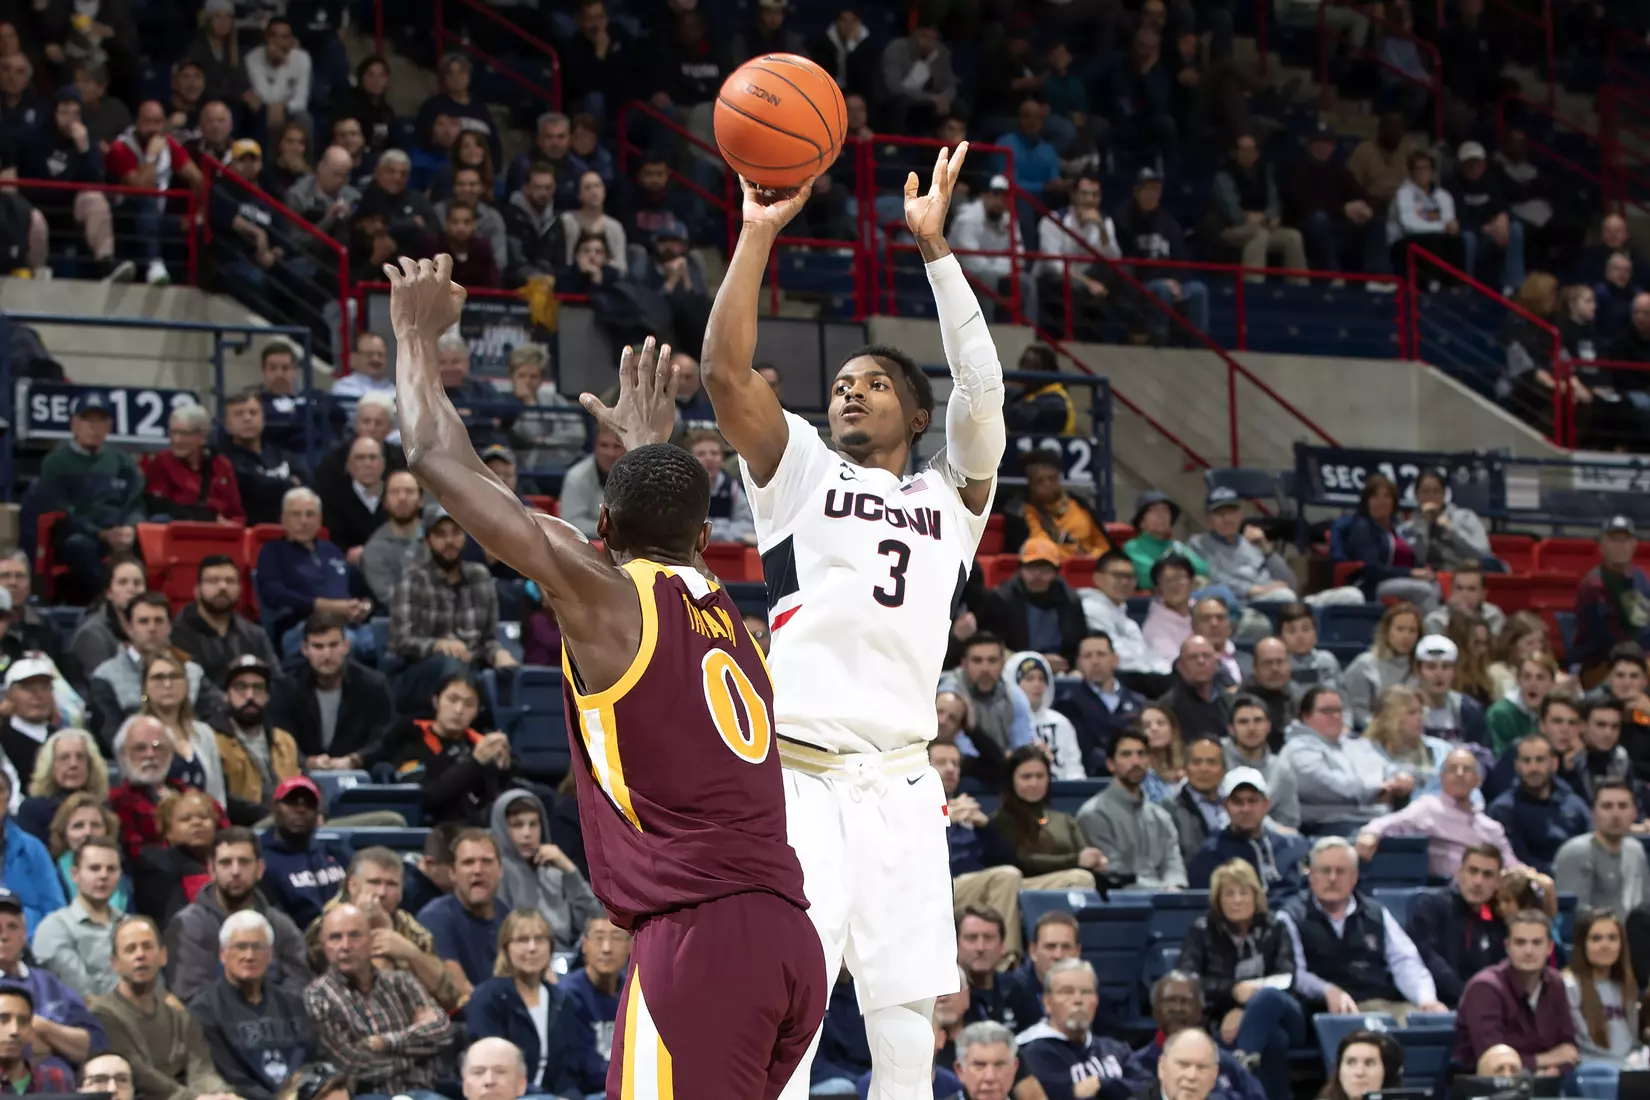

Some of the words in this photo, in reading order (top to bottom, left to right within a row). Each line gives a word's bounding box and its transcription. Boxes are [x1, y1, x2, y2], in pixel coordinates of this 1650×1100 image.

[31, 394, 78, 422] SE
[1321, 463, 1367, 490] SEC
[824, 488, 942, 540] UCONN
[872, 538, 911, 608] 3
[701, 648, 771, 764] 0
